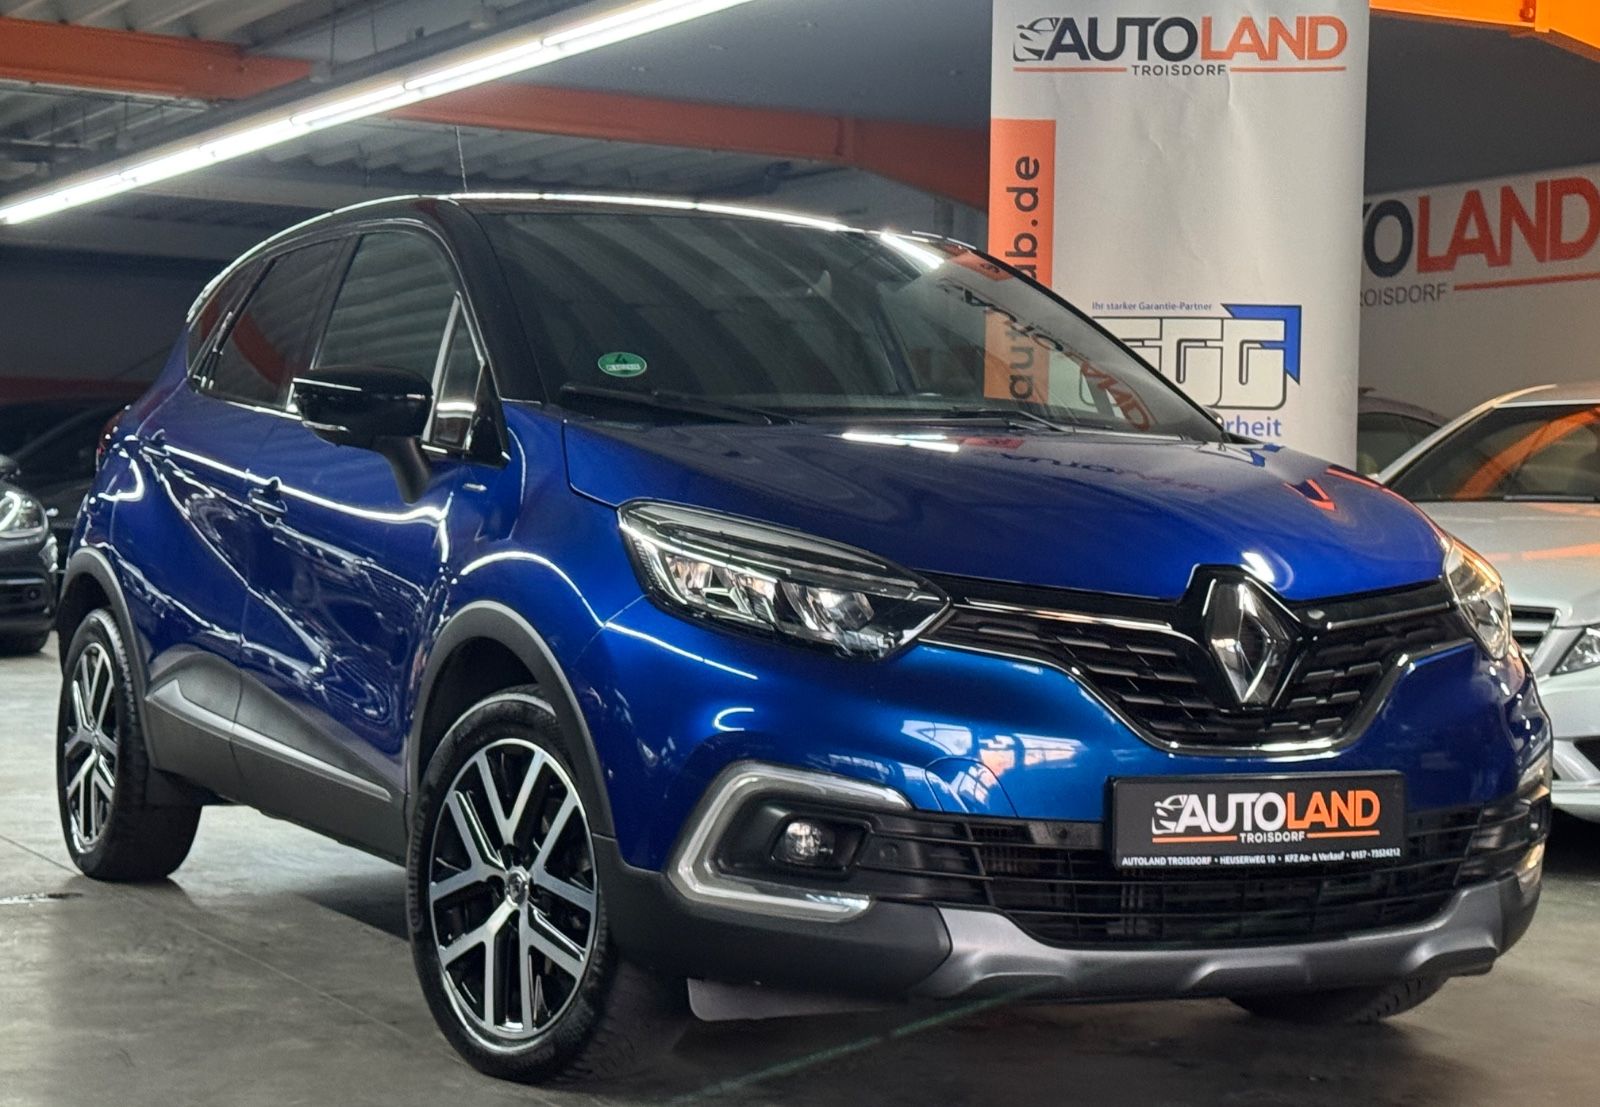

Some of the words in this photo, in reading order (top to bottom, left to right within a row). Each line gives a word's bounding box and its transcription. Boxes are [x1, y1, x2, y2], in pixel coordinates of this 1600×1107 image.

[1044, 15, 1348, 62] AUTOLAND
[1131, 63, 1227, 77] TROISDORF
[1362, 176, 1600, 279] OLAND
[1091, 301, 1104, 311] Ihr
[1106, 301, 1137, 311] starker
[1139, 301, 1213, 312] Garantie-Partner
[1360, 282, 1448, 308] OISDORF
[1225, 414, 1283, 437] rheit
[1174, 789, 1381, 834] AUTOLAND
[1239, 831, 1306, 845] TROISDORF
[1121, 856, 1167, 866] AUTOLAND
[1167, 856, 1212, 866] TROISDORF
[1219, 854, 1266, 865] HEUSERWEG
[1266, 854, 1276, 864] 10
